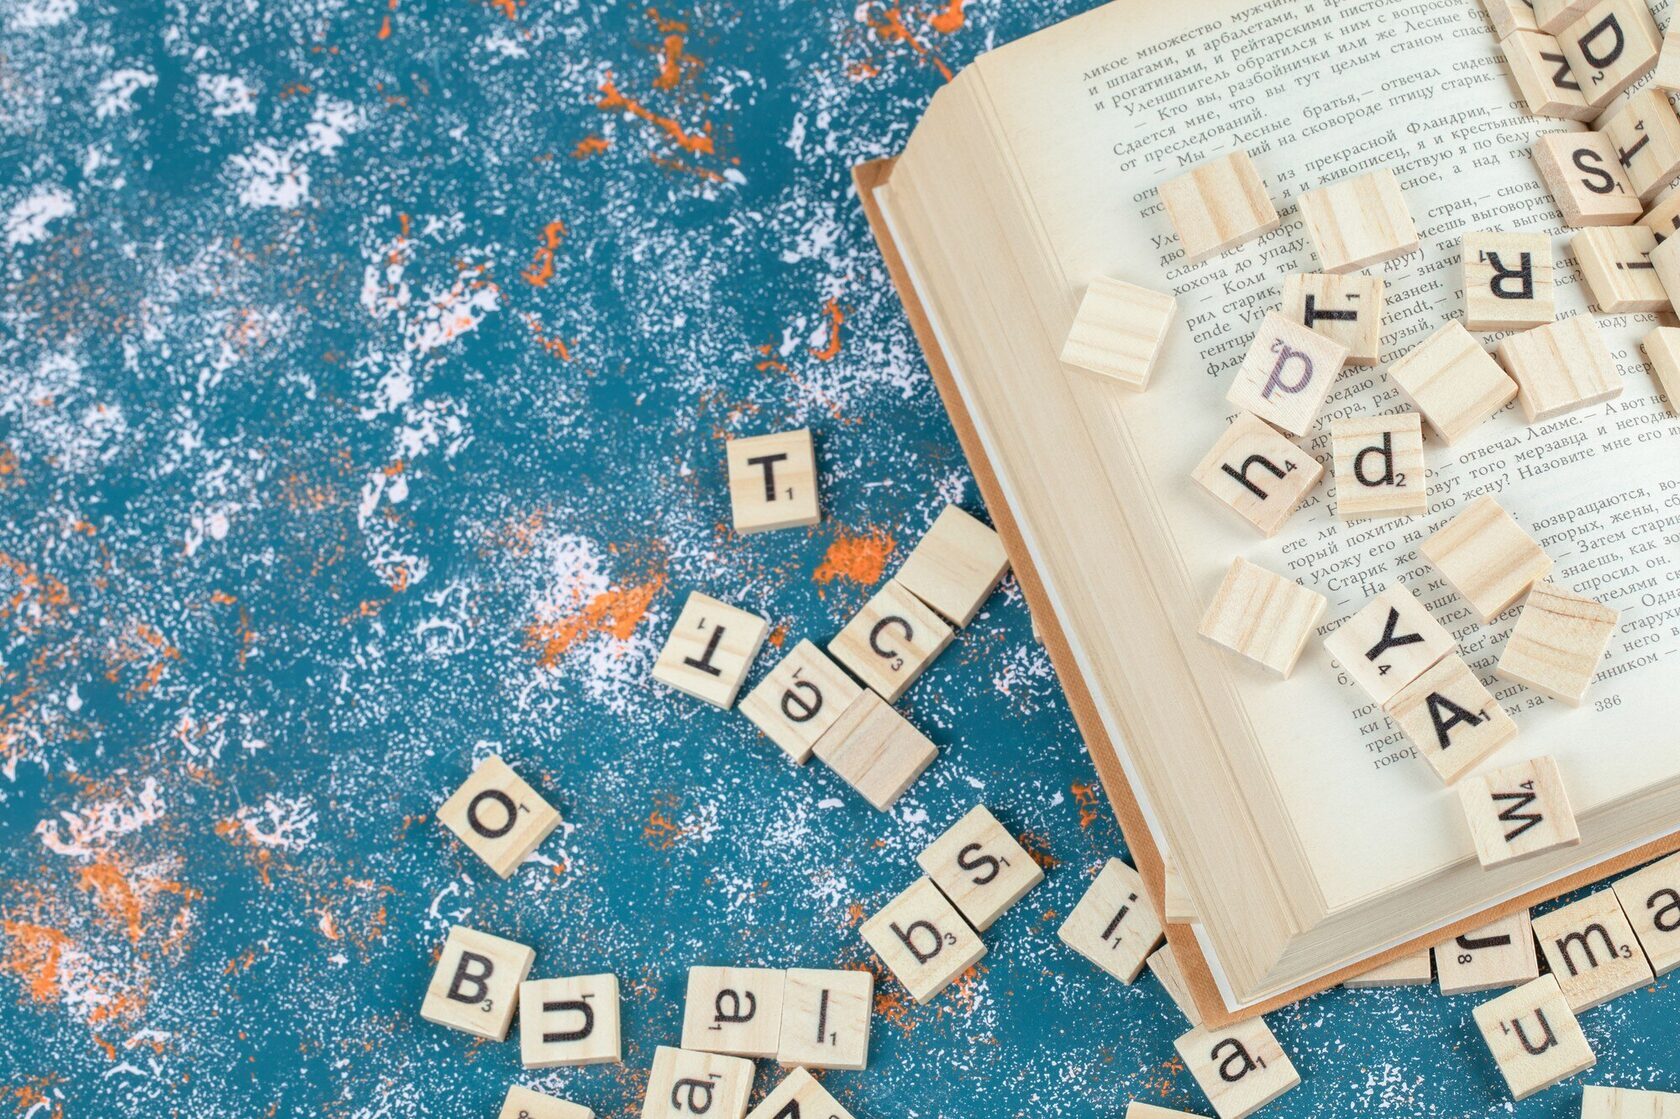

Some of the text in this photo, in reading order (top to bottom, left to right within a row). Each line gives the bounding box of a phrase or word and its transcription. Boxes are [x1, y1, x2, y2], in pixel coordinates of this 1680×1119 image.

[1083, 20, 1222, 81] ликое множество
[1106, 56, 1179, 89] шпагами,
[1203, 11, 1298, 52] арбалетами,
[1111, 62, 1207, 108] рогатинами,
[1230, 15, 1332, 61] рейтарскими
[1123, 70, 1230, 117] Уленшпигель
[1236, 37, 1317, 73] обратился
[1339, 19, 1371, 36] ним
[1157, 14, 1461, 121] Кто вы, разбойнички или же Лесные
[1113, 33, 1444, 156] Сдается мне, что вы тут целым станом
[1176, 151, 1205, 167] Мы
[1233, 117, 1292, 147] Лесные
[1381, 68, 1441, 91] отвечал
[1277, 133, 1297, 146] на
[1302, 102, 1383, 137] сковороде
[1388, 86, 1433, 107] птицу
[1120, 107, 1267, 172] от преследований.
[1276, 169, 1296, 183] из
[1304, 129, 1398, 172] прекрасной
[1472, 139, 1492, 150] по
[1496, 132, 1529, 144] белу
[1472, 155, 1500, 168] над
[1497, 181, 1540, 197] снова
[1172, 269, 1228, 297] хохоча
[1235, 259, 1252, 274] до
[1222, 272, 1266, 295] Коли
[1276, 260, 1298, 274] ты
[1486, 252, 1534, 299] R
[1186, 311, 1216, 332] рил
[1222, 286, 1281, 314] старик,
[1193, 323, 1232, 344] ende
[1459, 436, 1522, 464] отвечал
[1526, 416, 1582, 441] Ламме.
[1620, 398, 1645, 411] вот
[747, 452, 788, 502] T
[1221, 454, 1287, 501] h
[1353, 431, 1395, 487] d
[1469, 460, 1506, 479] того
[1514, 432, 1589, 463] мерзавца
[1517, 448, 1596, 480] Назовите
[1601, 437, 1632, 453] мне
[1637, 430, 1662, 443] его
[1531, 488, 1651, 532] возвращаются,
[1609, 504, 1659, 524] жены,
[1281, 526, 1337, 554] ете ли
[1287, 541, 1339, 570] торый
[1310, 530, 1423, 585] уложу его на
[1561, 540, 1657, 579] знаешь, как
[1577, 531, 1626, 553] Затем
[1327, 551, 1418, 591] Старик же
[1361, 582, 1387, 598] На
[1573, 556, 1671, 593] спросил он.
[683, 625, 726, 677] T
[1365, 605, 1425, 662] Y
[1623, 633, 1660, 653] него
[780, 680, 823, 723] e
[1425, 691, 1483, 751] A
[1595, 694, 1622, 712] 386
[889, 918, 944, 965] b
[1555, 923, 1620, 977] m
[446, 951, 494, 1004] B
[714, 988, 757, 1024] a
[1210, 1037, 1257, 1083] a
[671, 1077, 715, 1116] a
